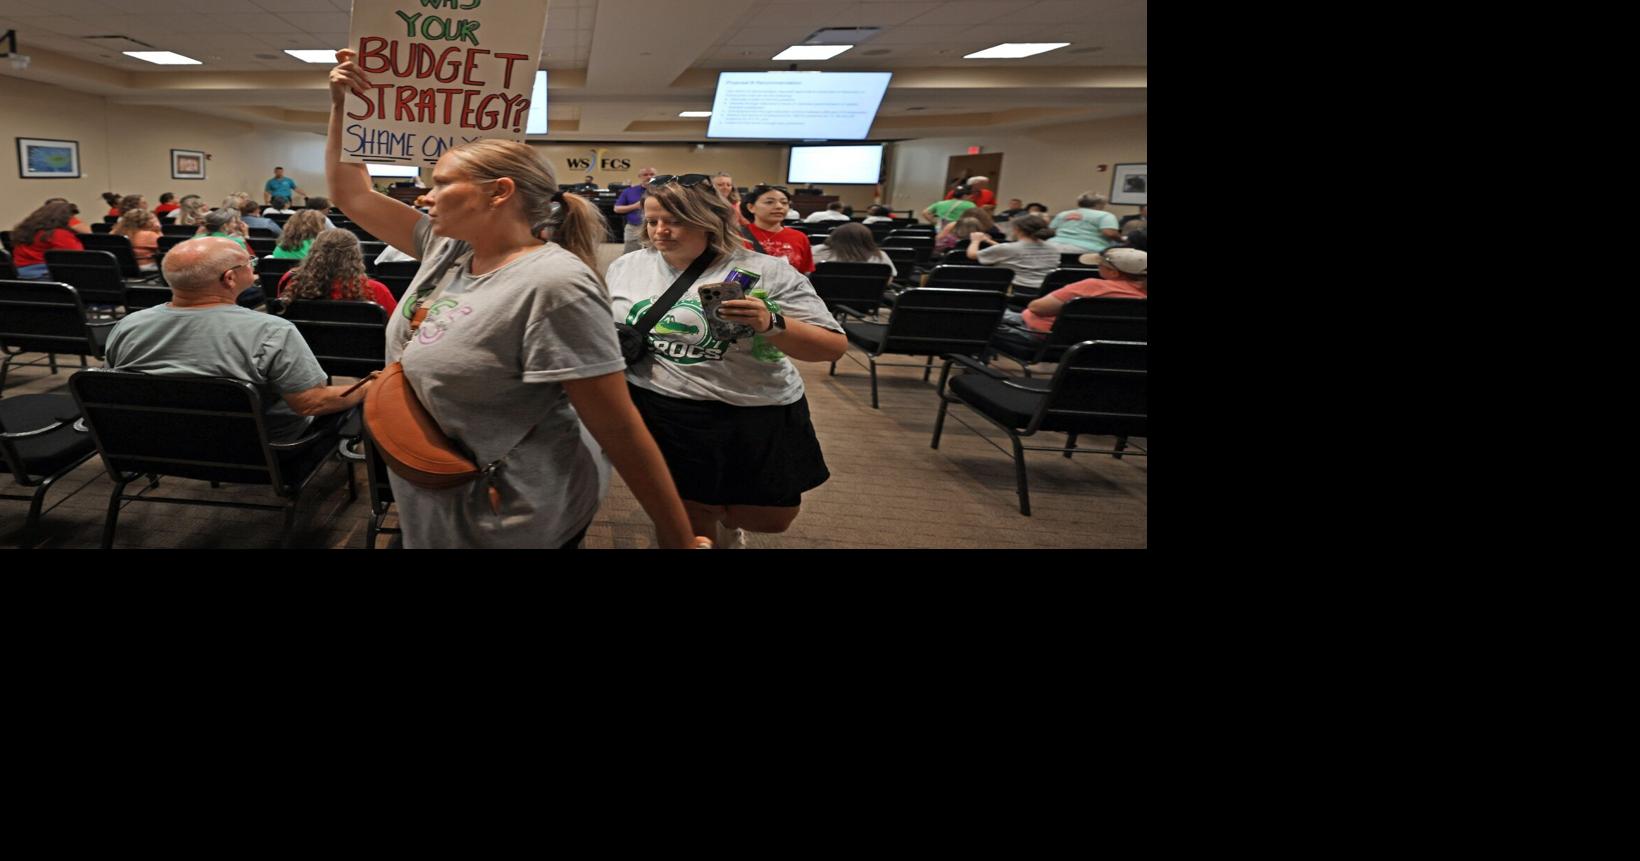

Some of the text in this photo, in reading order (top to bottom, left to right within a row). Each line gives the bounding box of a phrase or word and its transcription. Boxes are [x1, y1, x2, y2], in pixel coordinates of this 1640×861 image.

[395, 10, 481, 46] YOUR
[358, 36, 529, 89] BUDGET
[347, 83, 531, 133] STRATEGY?
[344, 124, 453, 157] SHAME ON
[566, 158, 631, 169] WS FCS
[651, 339, 724, 361] ROCS
